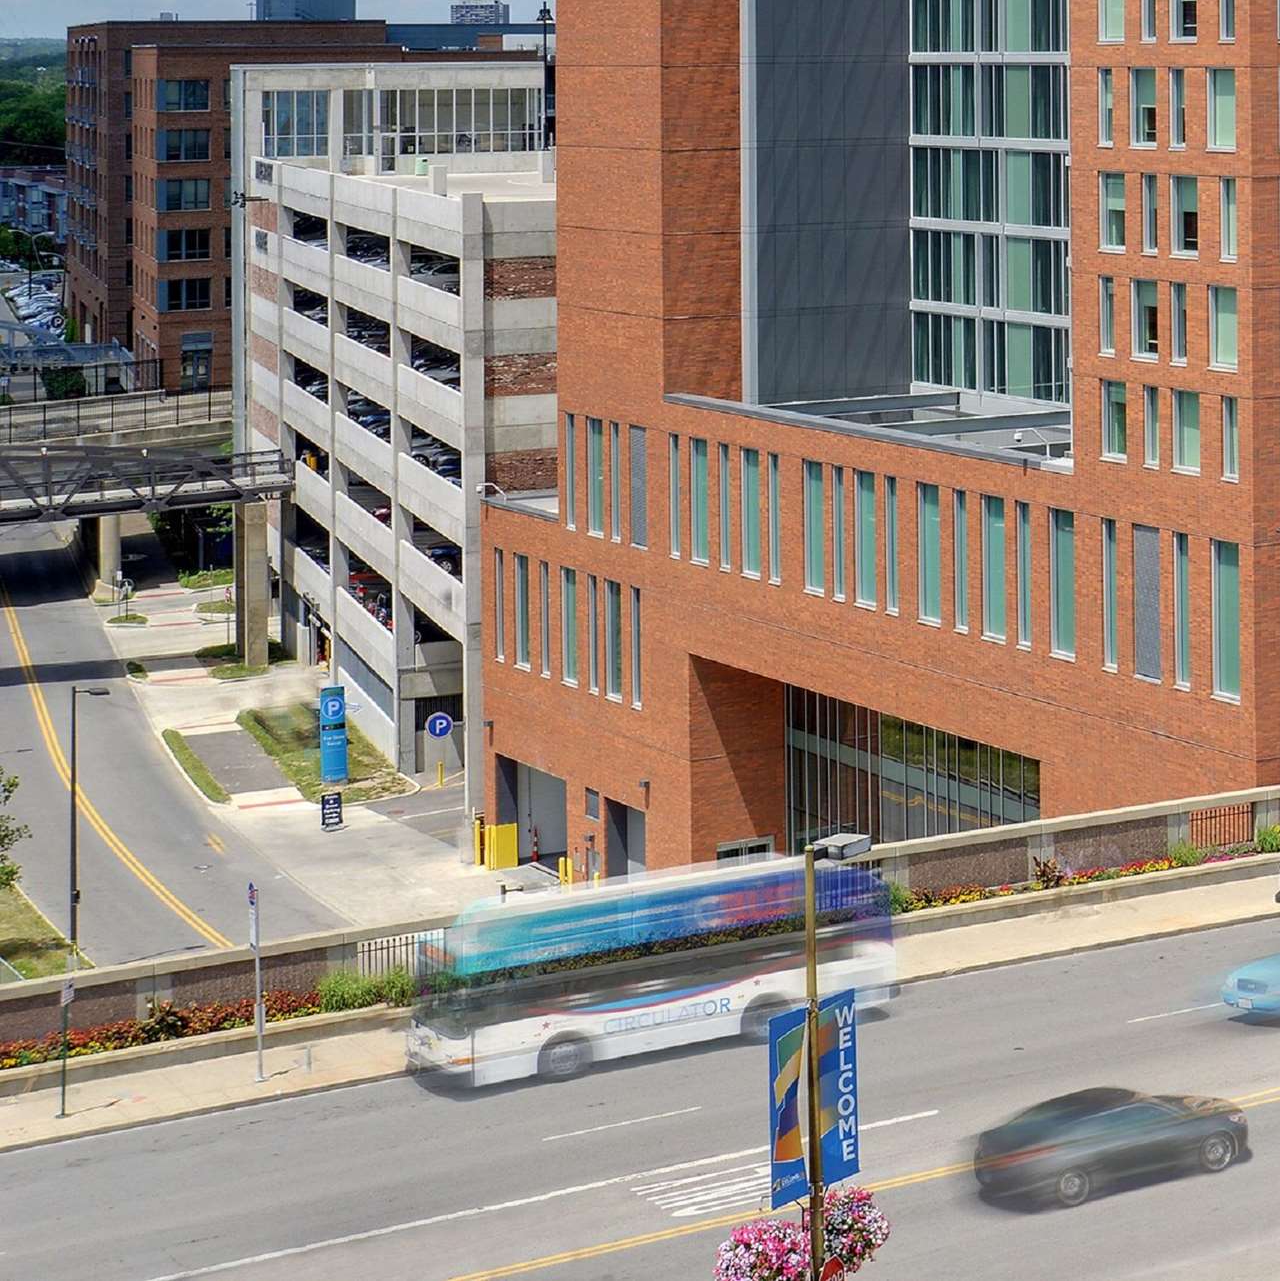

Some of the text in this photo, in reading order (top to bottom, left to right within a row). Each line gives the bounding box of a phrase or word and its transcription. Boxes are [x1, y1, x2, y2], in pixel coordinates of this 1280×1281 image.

[327, 700, 340, 716] P
[436, 719, 448, 734] P
[604, 997, 731, 1035] CIRCULATOR
[834, 1004, 856, 1162] WELCOME
